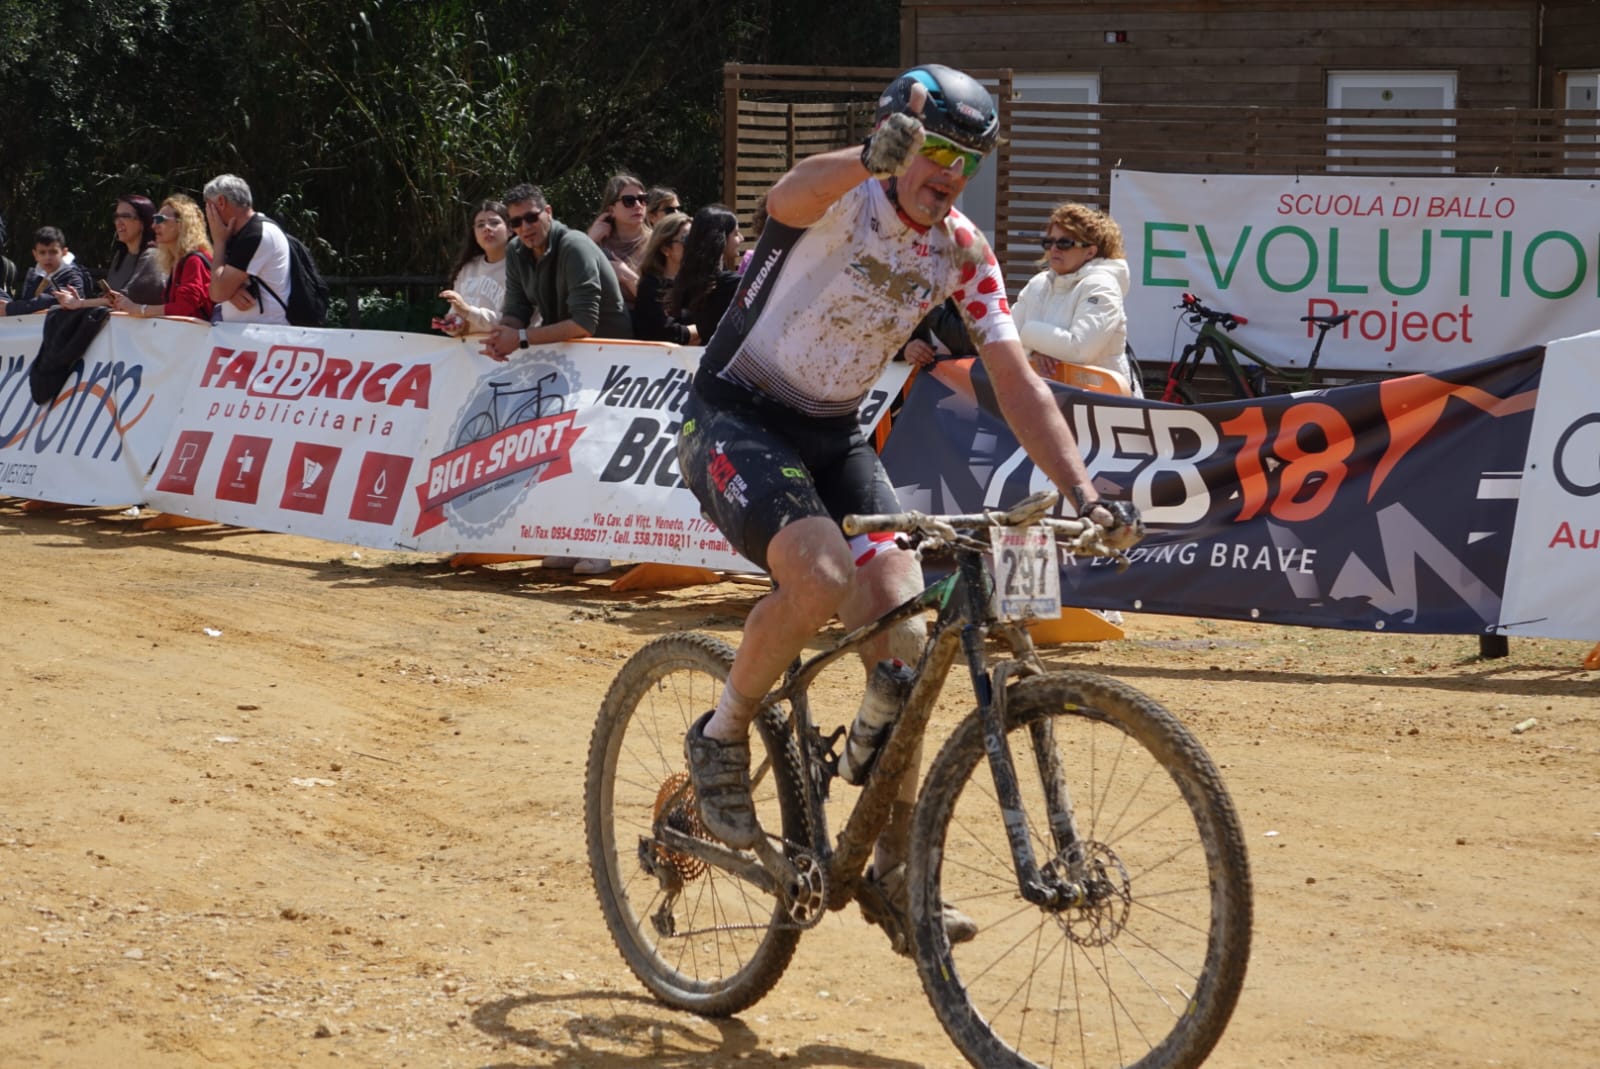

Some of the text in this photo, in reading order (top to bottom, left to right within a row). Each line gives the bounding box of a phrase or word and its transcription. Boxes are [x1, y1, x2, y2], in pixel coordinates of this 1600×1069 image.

[1277, 193, 1515, 219] SCUOLA DI BALLO
[1142, 221, 1600, 300] EVOLUTIO
[1307, 298, 1473, 352] Project
[199, 345, 432, 410] FABBRICA
[592, 365, 693, 413] Vendit
[207, 399, 393, 437] pubblicitaria
[428, 451, 471, 500] BICI
[485, 418, 572, 475] SPORT
[551, 526, 608, 542] 0934.930517
[613, 530, 630, 544] Cell.
[633, 531, 691, 549] 338.7818211
[700, 537, 729, 552] e-mail:
[593, 513, 606, 526] Via
[607, 513, 622, 526] Cav.
[624, 514, 633, 527] di
[655, 516, 684, 532] Veneto,
[1002, 549, 1049, 596] 297
[1210, 542, 1317, 574] BRAVE
